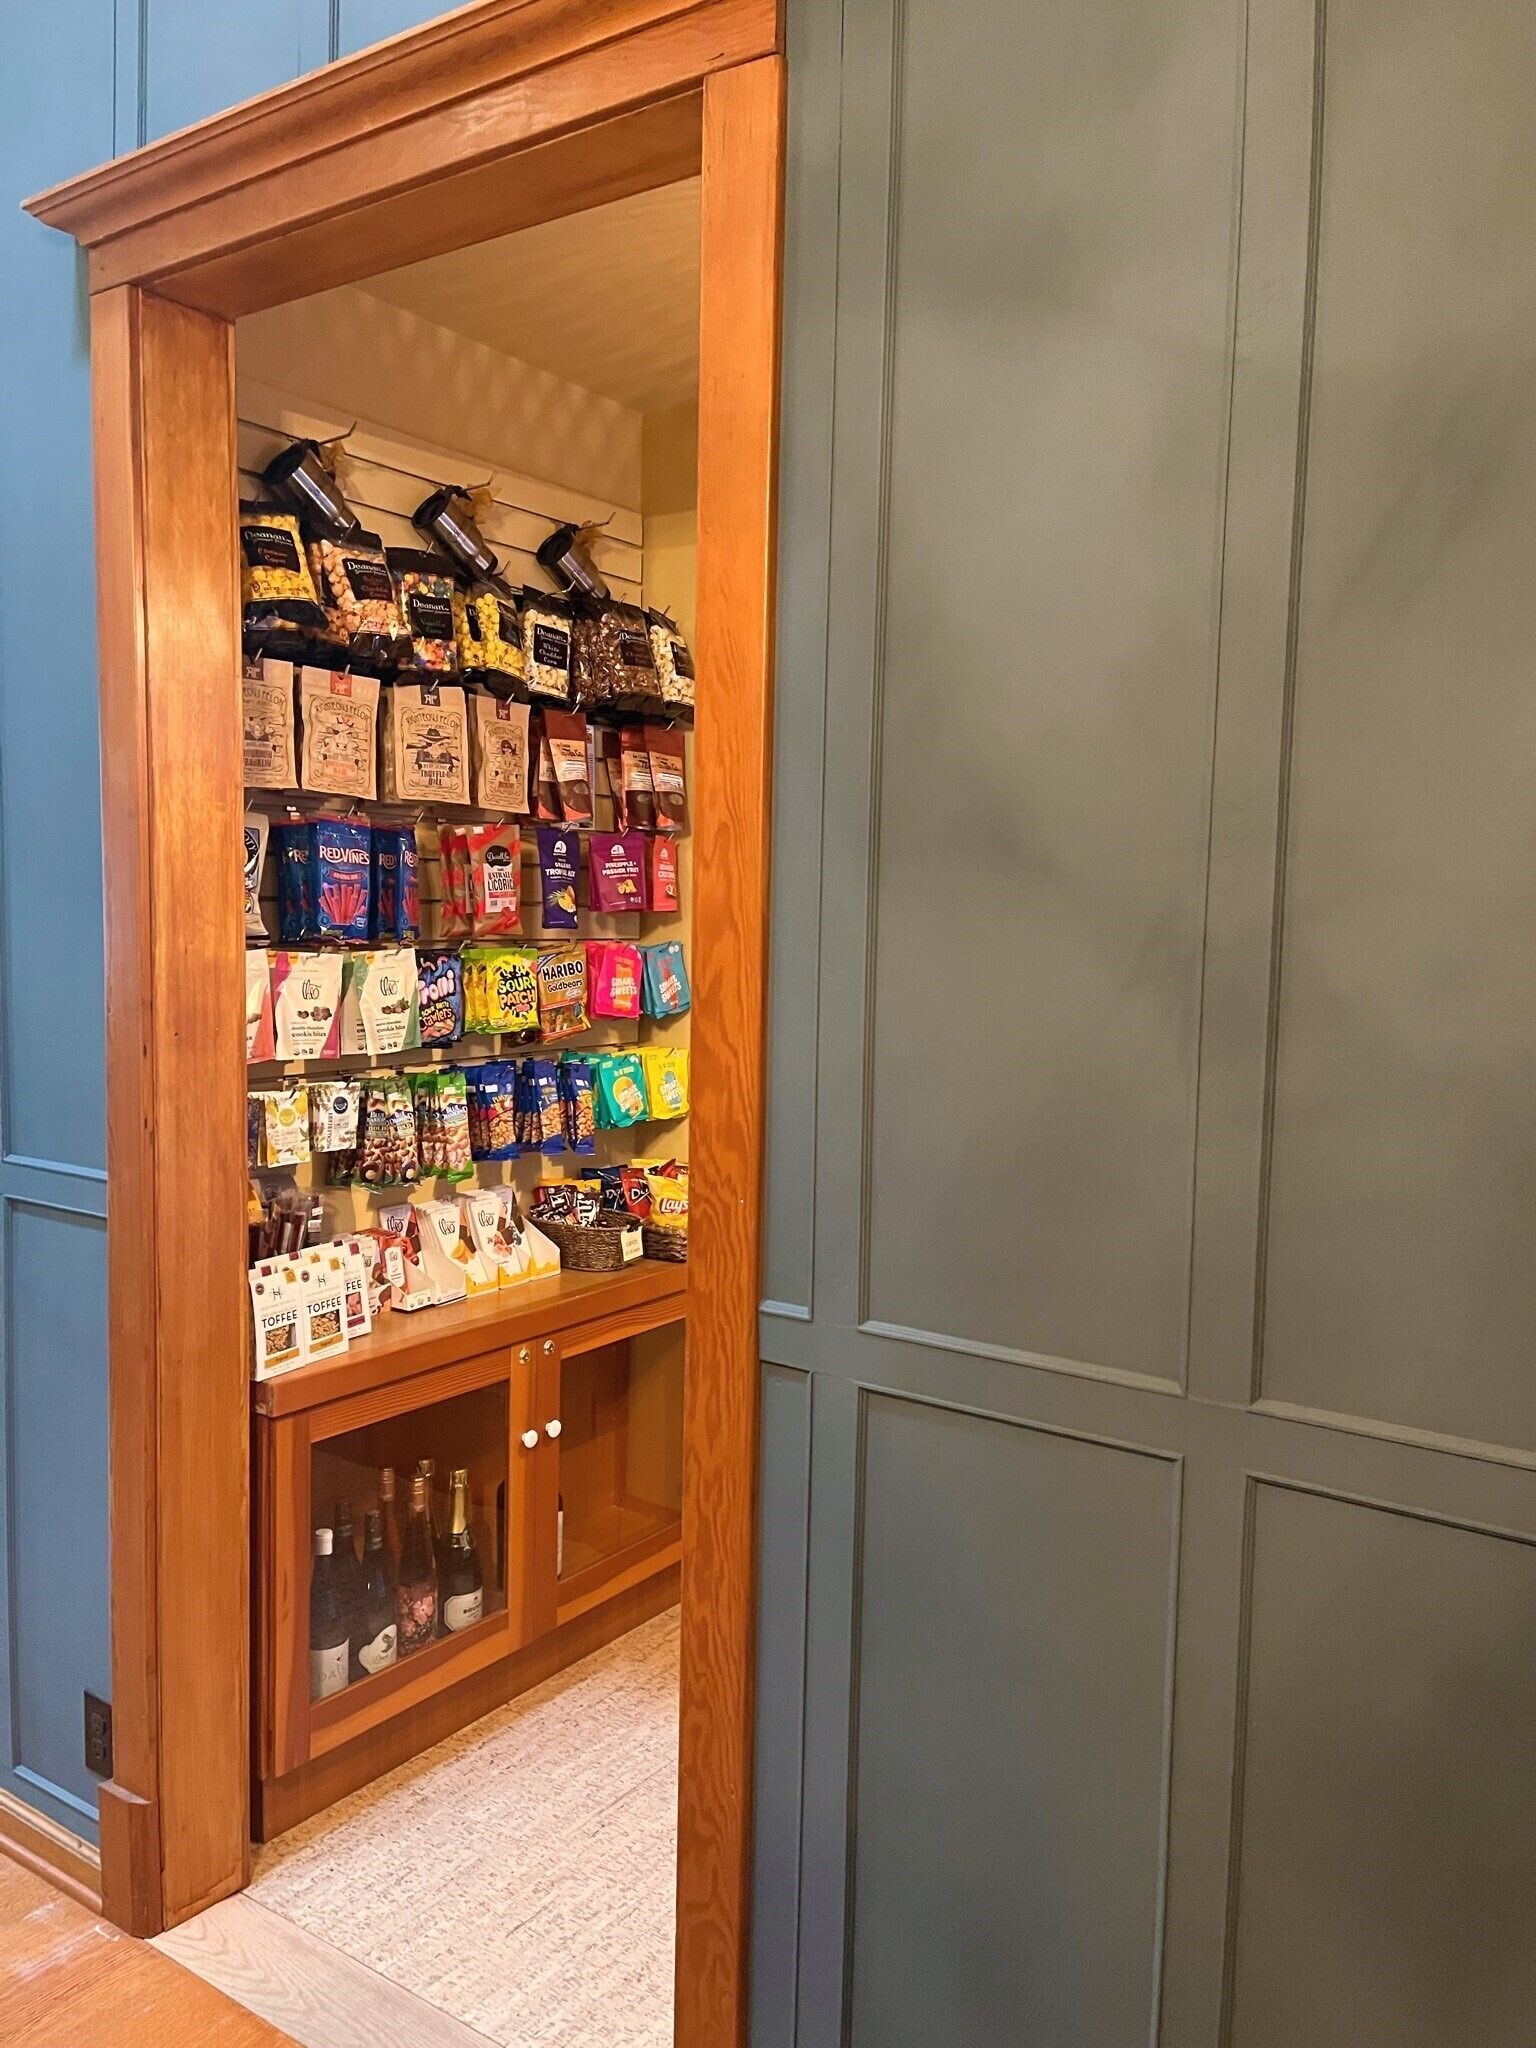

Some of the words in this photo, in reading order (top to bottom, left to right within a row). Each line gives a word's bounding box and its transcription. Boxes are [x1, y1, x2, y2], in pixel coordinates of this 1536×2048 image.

[542, 960, 583, 981] HARIBO
[547, 979, 583, 992] Goldbears
[499, 988, 536, 1008] PATCH
[419, 1008, 452, 1026] rawlers
[345, 1279, 362, 1292] FEE
[306, 1295, 342, 1315] TOFFEE
[261, 1309, 298, 1329] TOFFEE
